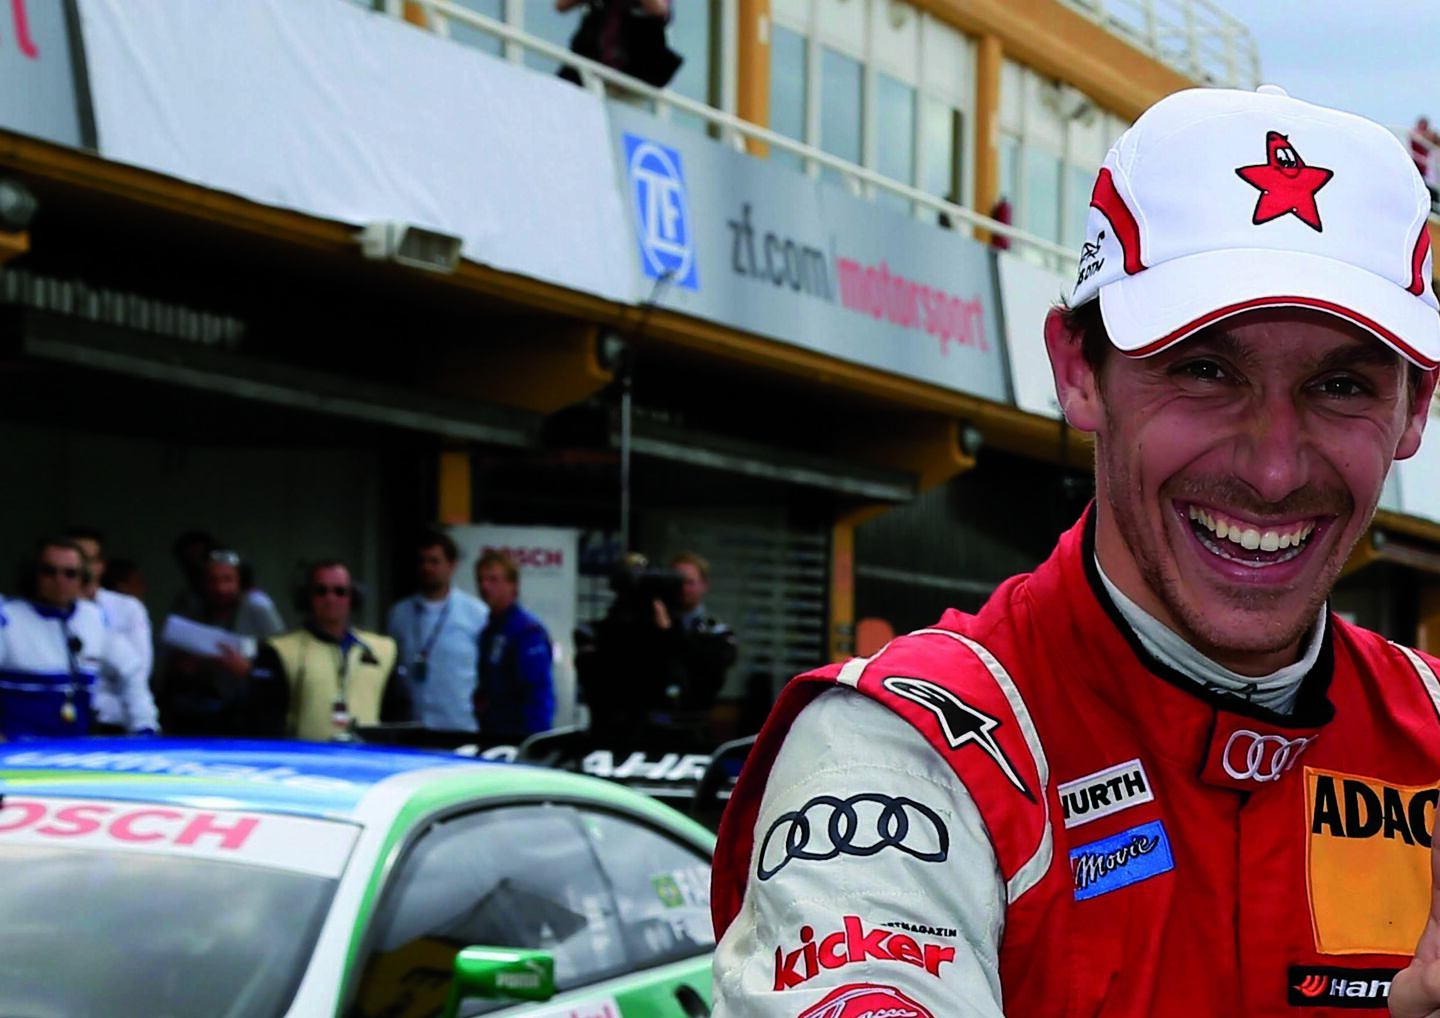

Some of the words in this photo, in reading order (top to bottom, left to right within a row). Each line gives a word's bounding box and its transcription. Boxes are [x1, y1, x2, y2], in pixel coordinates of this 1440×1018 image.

[0, 801, 260, 850] OSCH
[1311, 775, 1440, 848] ADAC
[1075, 835, 1159, 890] Movie
[773, 916, 956, 991] kicker
[1329, 978, 1392, 998] Han
